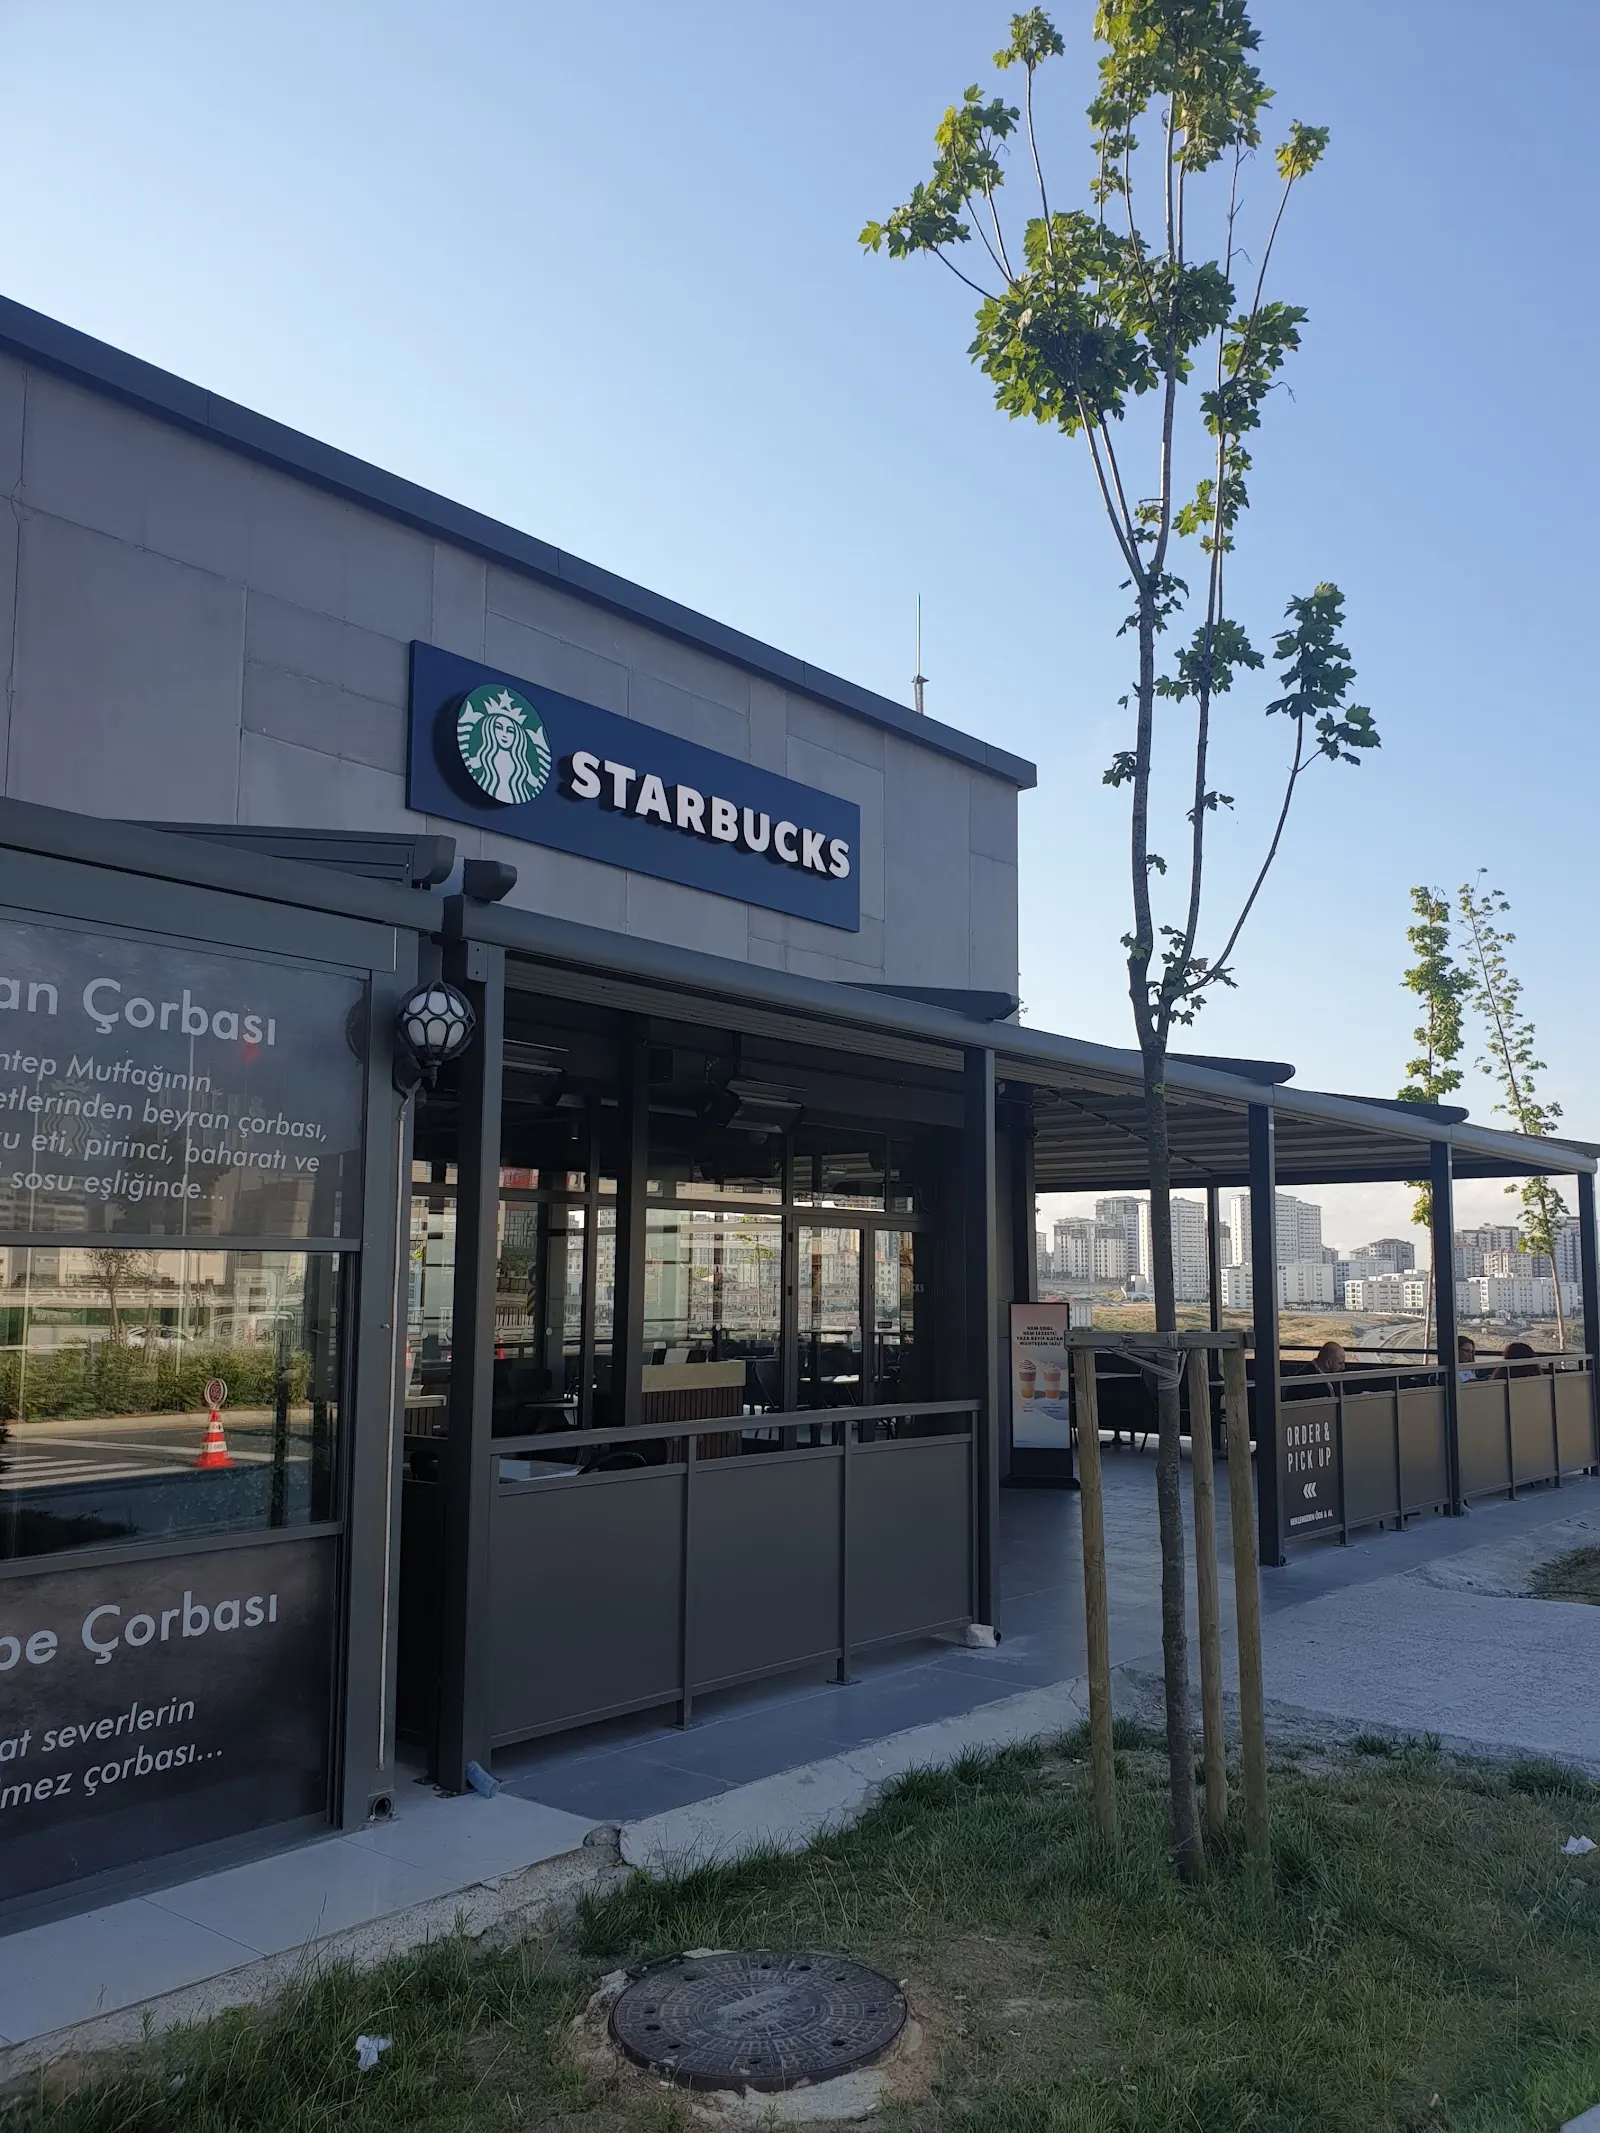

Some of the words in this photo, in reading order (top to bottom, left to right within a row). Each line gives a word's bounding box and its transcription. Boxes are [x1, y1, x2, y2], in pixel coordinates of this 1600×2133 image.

[570, 750, 851, 879] STARBUCKS
[0, 977, 59, 1016] an
[82, 977, 276, 1045] Çorbası
[66, 1053, 212, 1094] Mutfağının
[143, 1094, 230, 1132] beyran
[238, 1112, 328, 1143] çorbası,
[31, 1132, 73, 1158] eti,
[84, 1134, 175, 1165] pirinci,
[185, 1143, 287, 1171] baharatı
[294, 1155, 321, 1174] ve
[10, 1172, 74, 1192] sosu
[84, 1169, 225, 1203] eşliğinde...
[1286, 1423, 1320, 1446] ORDER
[1324, 1422, 1330, 1441] &
[1288, 1450, 1313, 1473] PICK
[1318, 1447, 1331, 1468] UP
[81, 1590, 279, 1665] Çorbası
[0, 1731, 32, 1763] at
[41, 1696, 196, 1754] severlerin
[83, 1743, 224, 1797] çorbası...
